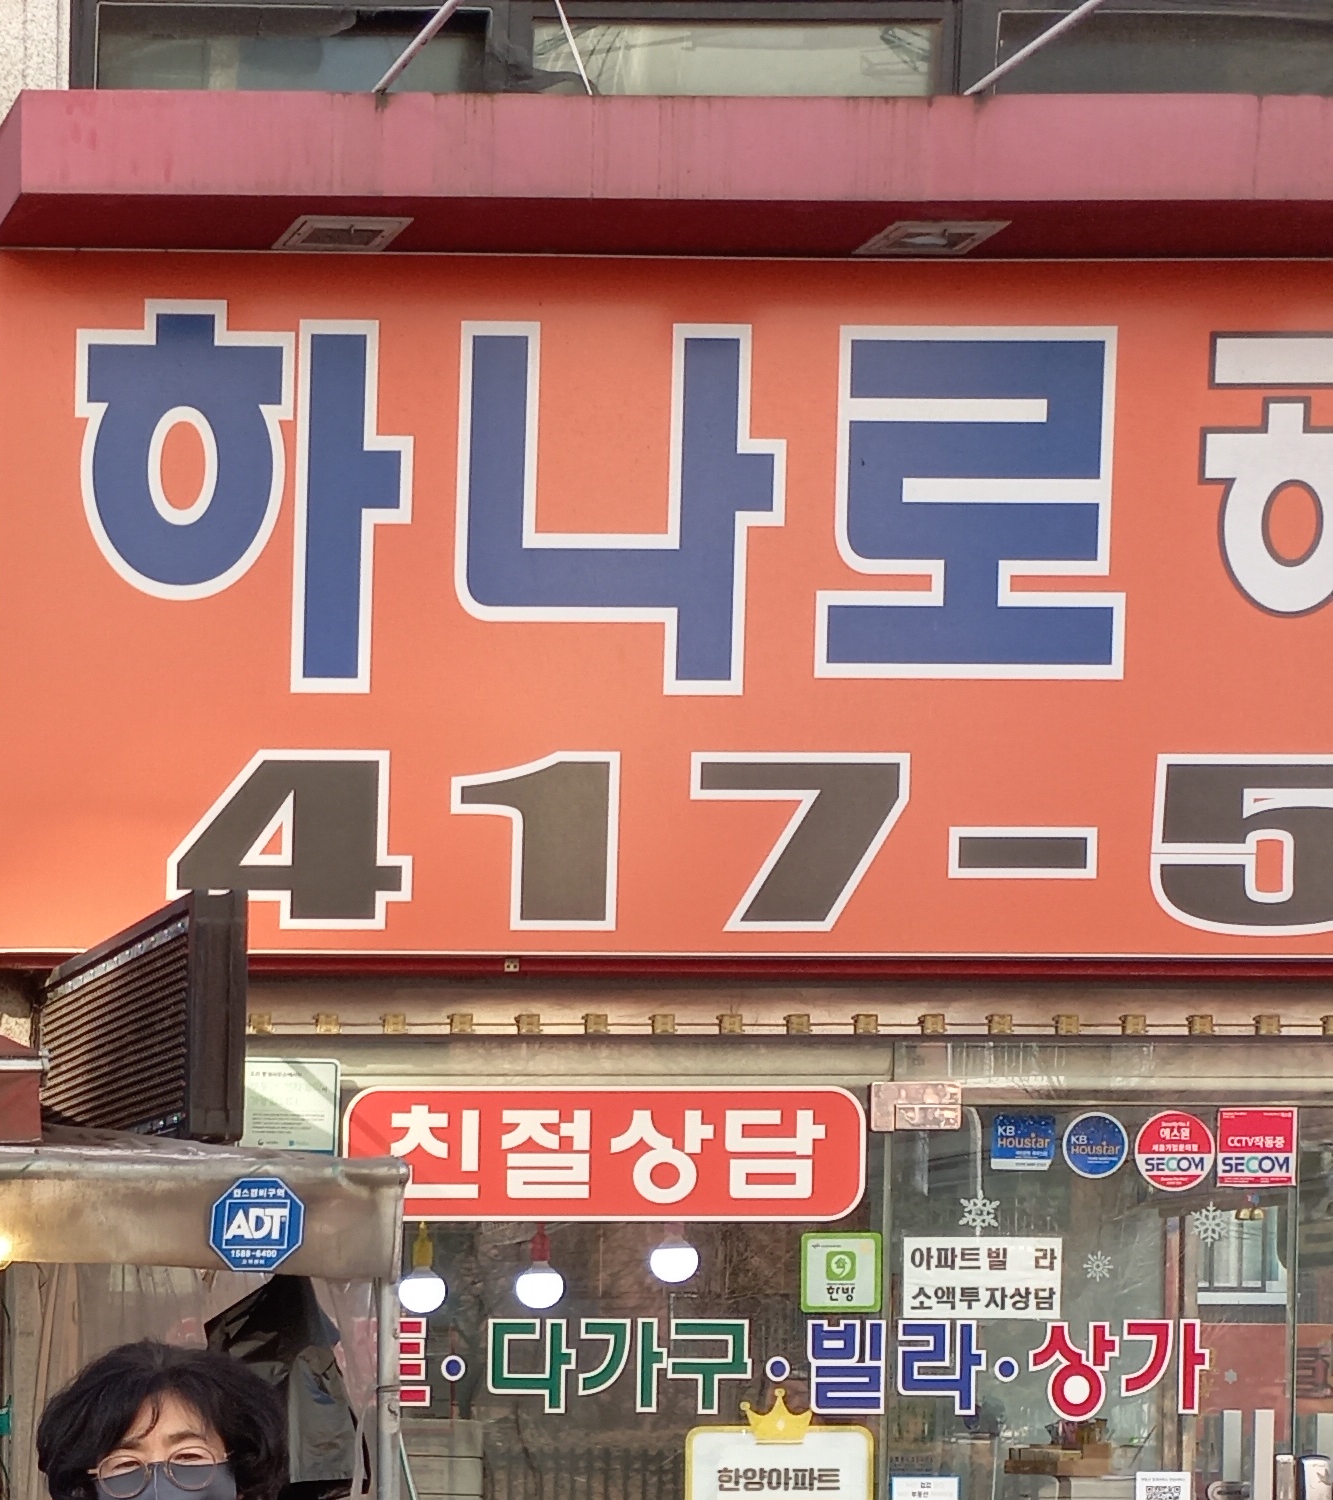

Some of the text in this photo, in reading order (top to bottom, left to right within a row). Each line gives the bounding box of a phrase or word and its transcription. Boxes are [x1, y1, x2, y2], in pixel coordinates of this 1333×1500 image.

[75, 299, 1127, 695] 하나로
[997, 1126, 1015, 1136] KB
[1071, 1135, 1088, 1145] KB
[390, 1105, 827, 1204] 친절상담
[1145, 1157, 1204, 1172] SECOM
[1222, 1156, 1290, 1173] SECOM
[224, 1207, 288, 1240] ADT
[826, 1285, 855, 1302] 한방
[717, 1467, 841, 1492] 한양아파트
